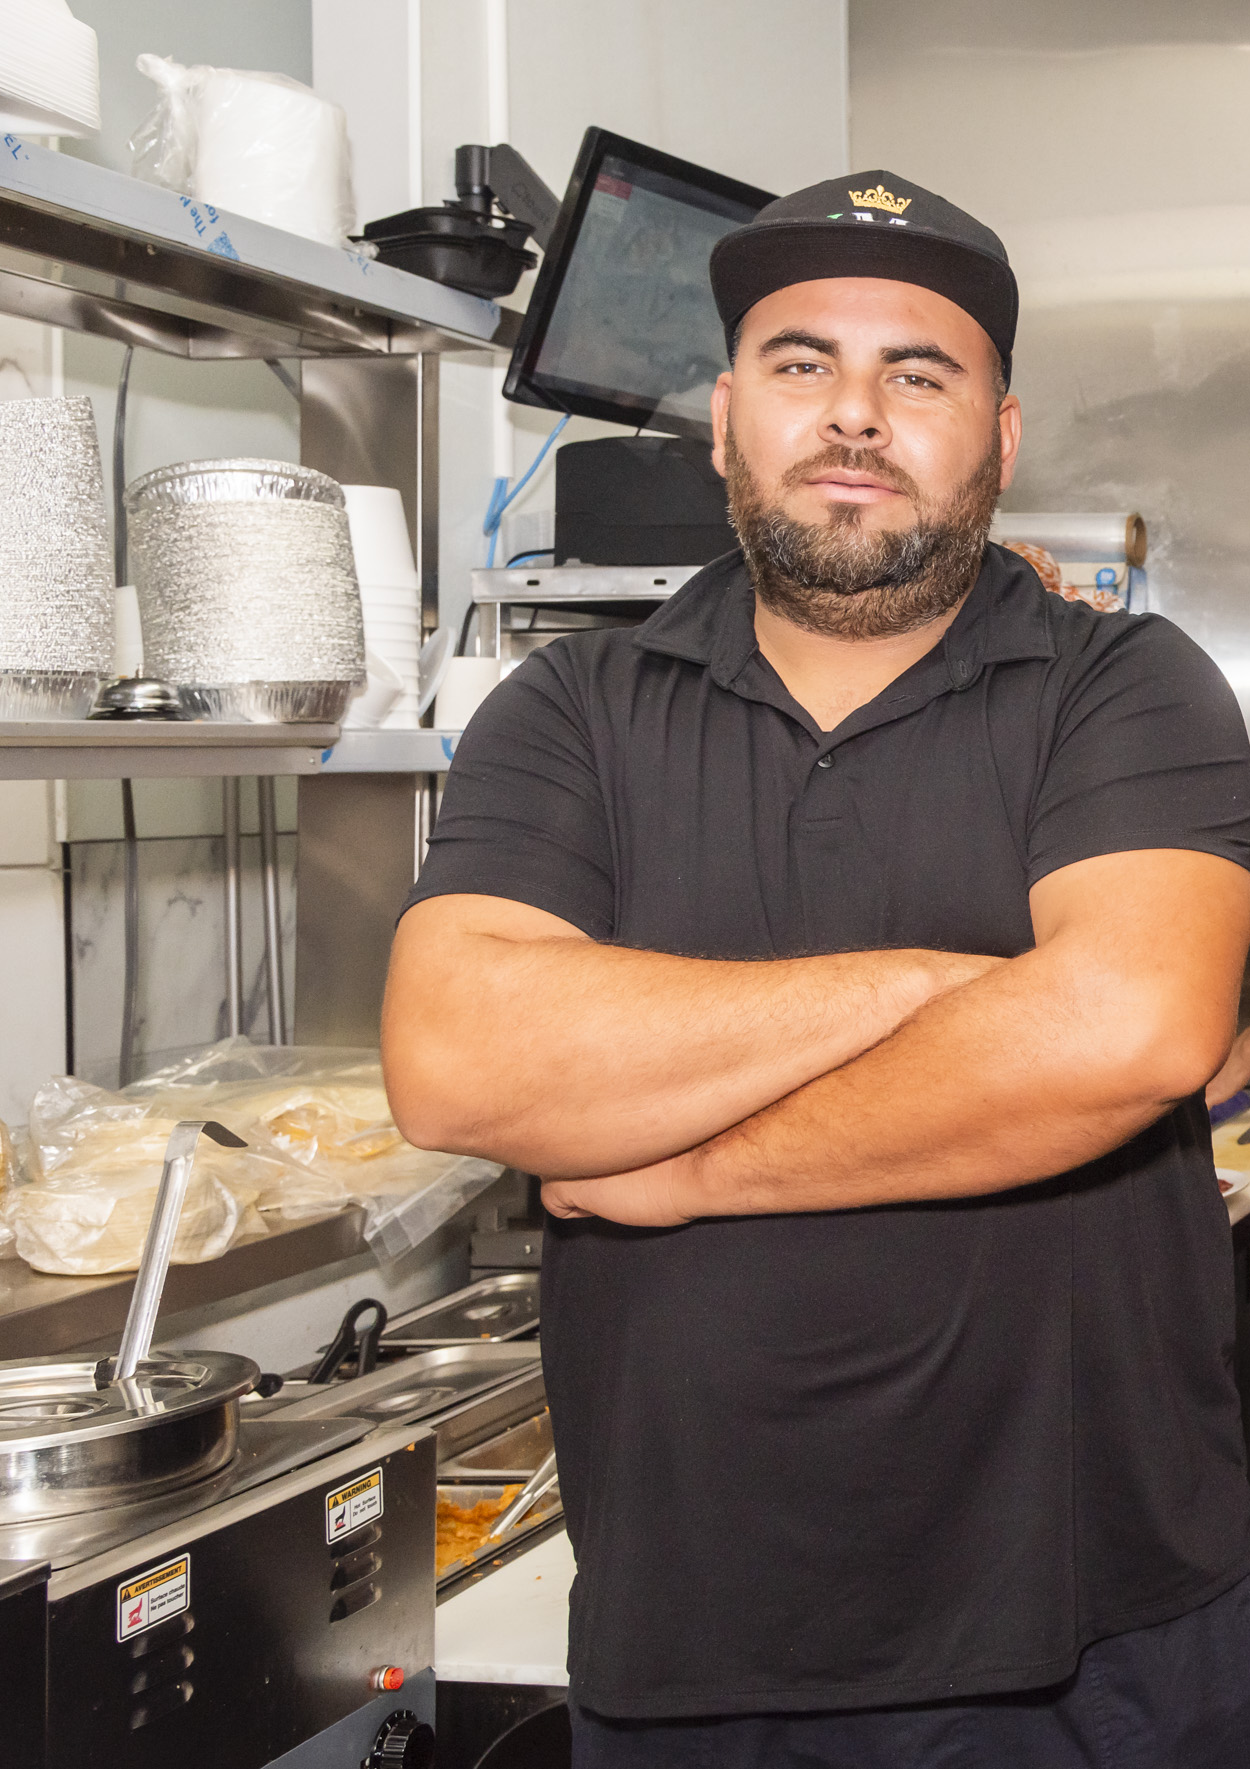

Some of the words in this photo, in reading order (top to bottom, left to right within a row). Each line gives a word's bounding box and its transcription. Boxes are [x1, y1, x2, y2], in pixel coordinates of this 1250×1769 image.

[191, 206, 207, 237] The
[341, 1480, 372, 1501] WARNING
[134, 1565, 182, 1594] AVERTISSEMENT
[150, 1592, 168, 1605] Surface
[157, 1600, 166, 1609] pas
[166, 1592, 184, 1604] toucher
